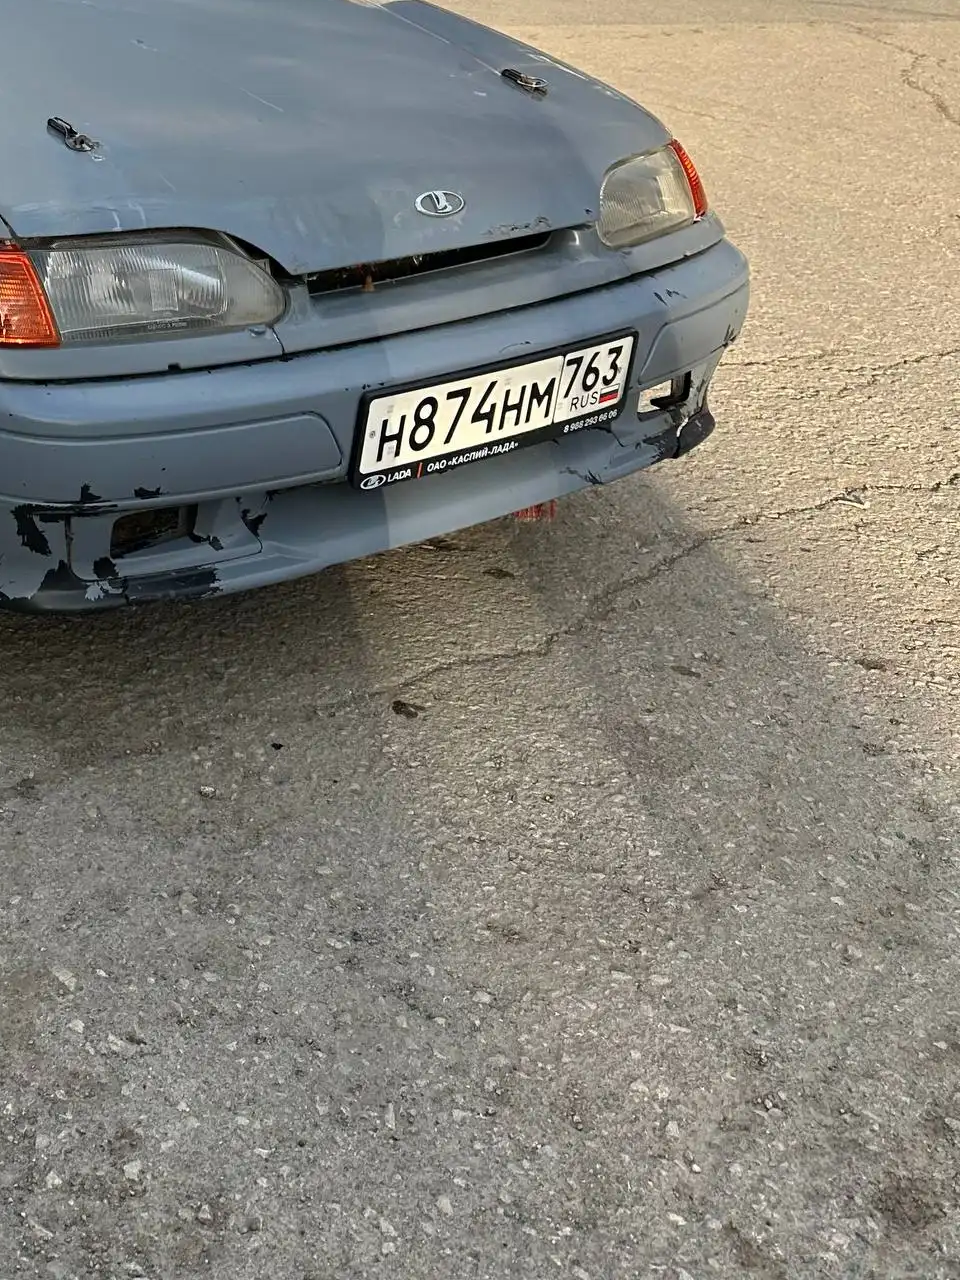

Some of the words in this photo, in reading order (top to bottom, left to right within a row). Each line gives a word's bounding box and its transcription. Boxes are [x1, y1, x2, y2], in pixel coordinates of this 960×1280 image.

[376, 377, 557, 462] Н874НМ
[563, 345, 624, 399] 763
[569, 391, 599, 413] RUS
[563, 424, 570, 433] 8
[427, 460, 447, 472] ОАО
[387, 468, 412, 483] LADA
